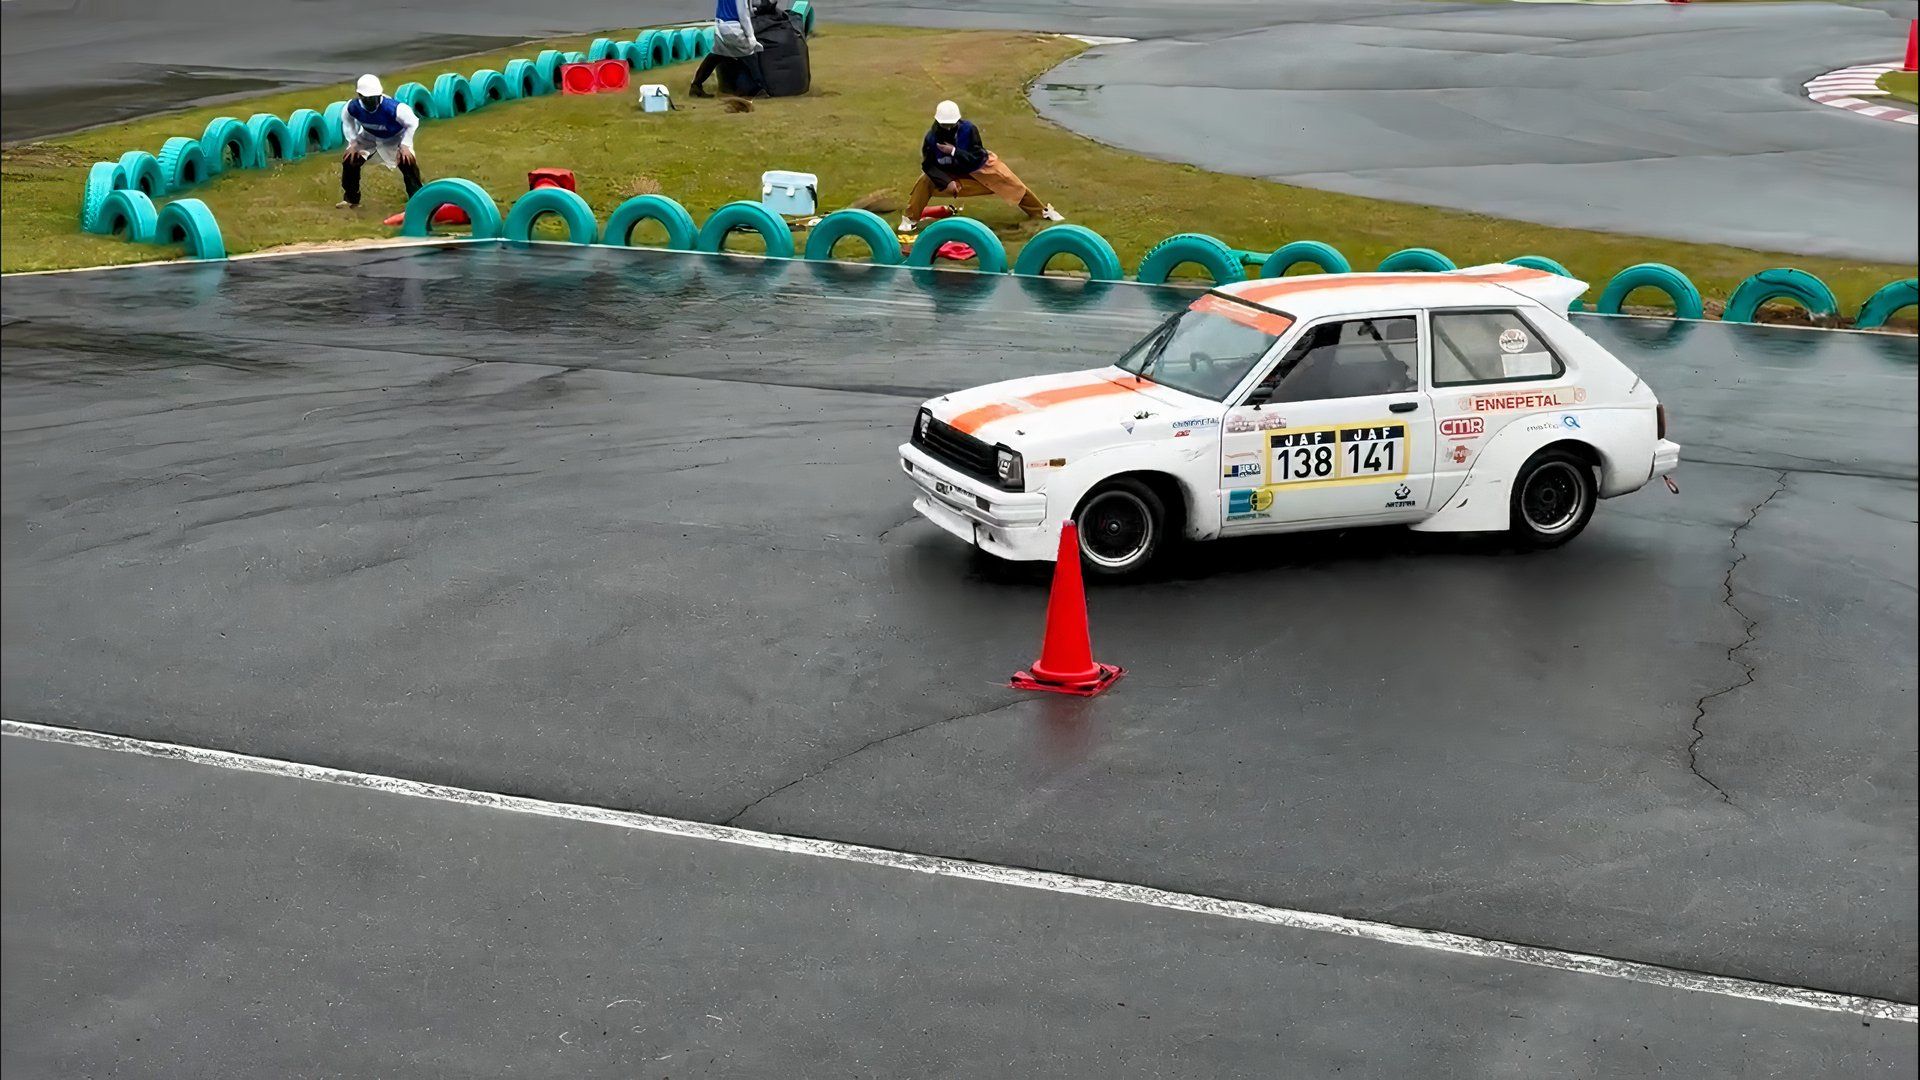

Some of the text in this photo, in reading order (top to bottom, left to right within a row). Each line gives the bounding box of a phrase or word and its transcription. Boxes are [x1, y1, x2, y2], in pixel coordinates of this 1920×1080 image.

[1475, 394, 1561, 411] ENNEPETAL
[1277, 446, 1332, 480] 138
[1348, 441, 1394, 474] 141
